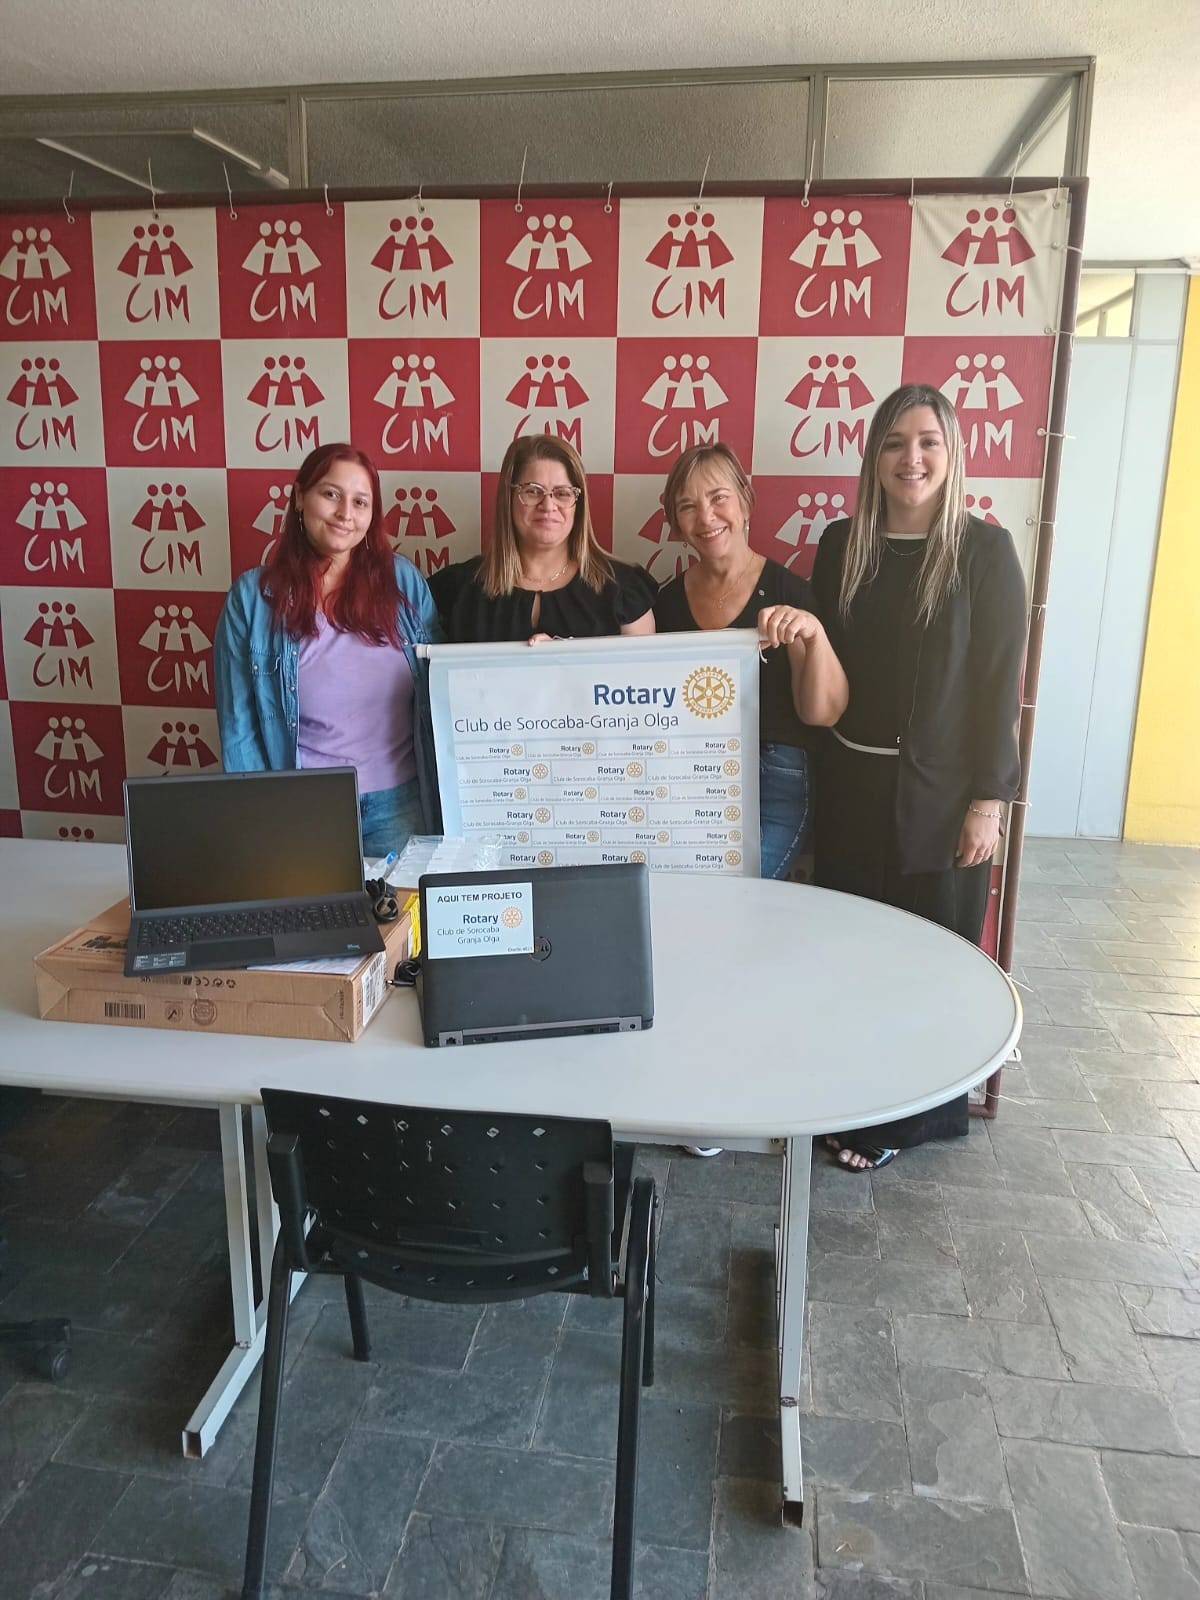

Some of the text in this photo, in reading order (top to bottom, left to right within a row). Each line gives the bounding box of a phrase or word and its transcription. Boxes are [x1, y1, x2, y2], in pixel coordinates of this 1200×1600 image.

[6, 285, 69, 326] CIM
[126, 282, 191, 324] CIM
[249, 280, 317, 323] CIM
[378, 277, 448, 321] CIM
[512, 276, 585, 321] CIM
[652, 274, 725, 320] CIM
[794, 273, 872, 319] CIM
[946, 272, 1025, 319] CIM
[16, 412, 77, 452] CIM
[132, 412, 196, 453] CIM
[255, 413, 320, 452] CIM
[381, 413, 450, 457] CIM
[648, 414, 720, 457] CIM
[790, 415, 865, 459] CIM
[964, 419, 1013, 462] IM
[24, 535, 86, 574] CIM
[140, 537, 203, 576] CIM
[33, 653, 94, 690] CIM
[147, 656, 210, 696] CIM
[593, 684, 677, 708] Rotary
[454, 712, 679, 733] Club de Sorocaba-Granja Olga
[632, 743, 653, 751] Rotary
[705, 742, 726, 750] Rotary
[44, 765, 103, 802] CIM
[503, 767, 531, 777] Rotary
[598, 766, 625, 776] Rotary
[693, 764, 721, 774] Rotary
[507, 810, 534, 820] Rotary
[600, 810, 627, 820] Rotary
[695, 809, 722, 819] Rotary
[510, 854, 536, 863] Rotary
[602, 853, 629, 863] Rotary
[696, 853, 723, 863] Rotary
[437, 892, 523, 903] AQUI TEM PROJETO
[437, 925, 500, 936] Club de Sorocaba
[463, 914, 499, 925] Rotary
[457, 935, 500, 945] Granja Olga
